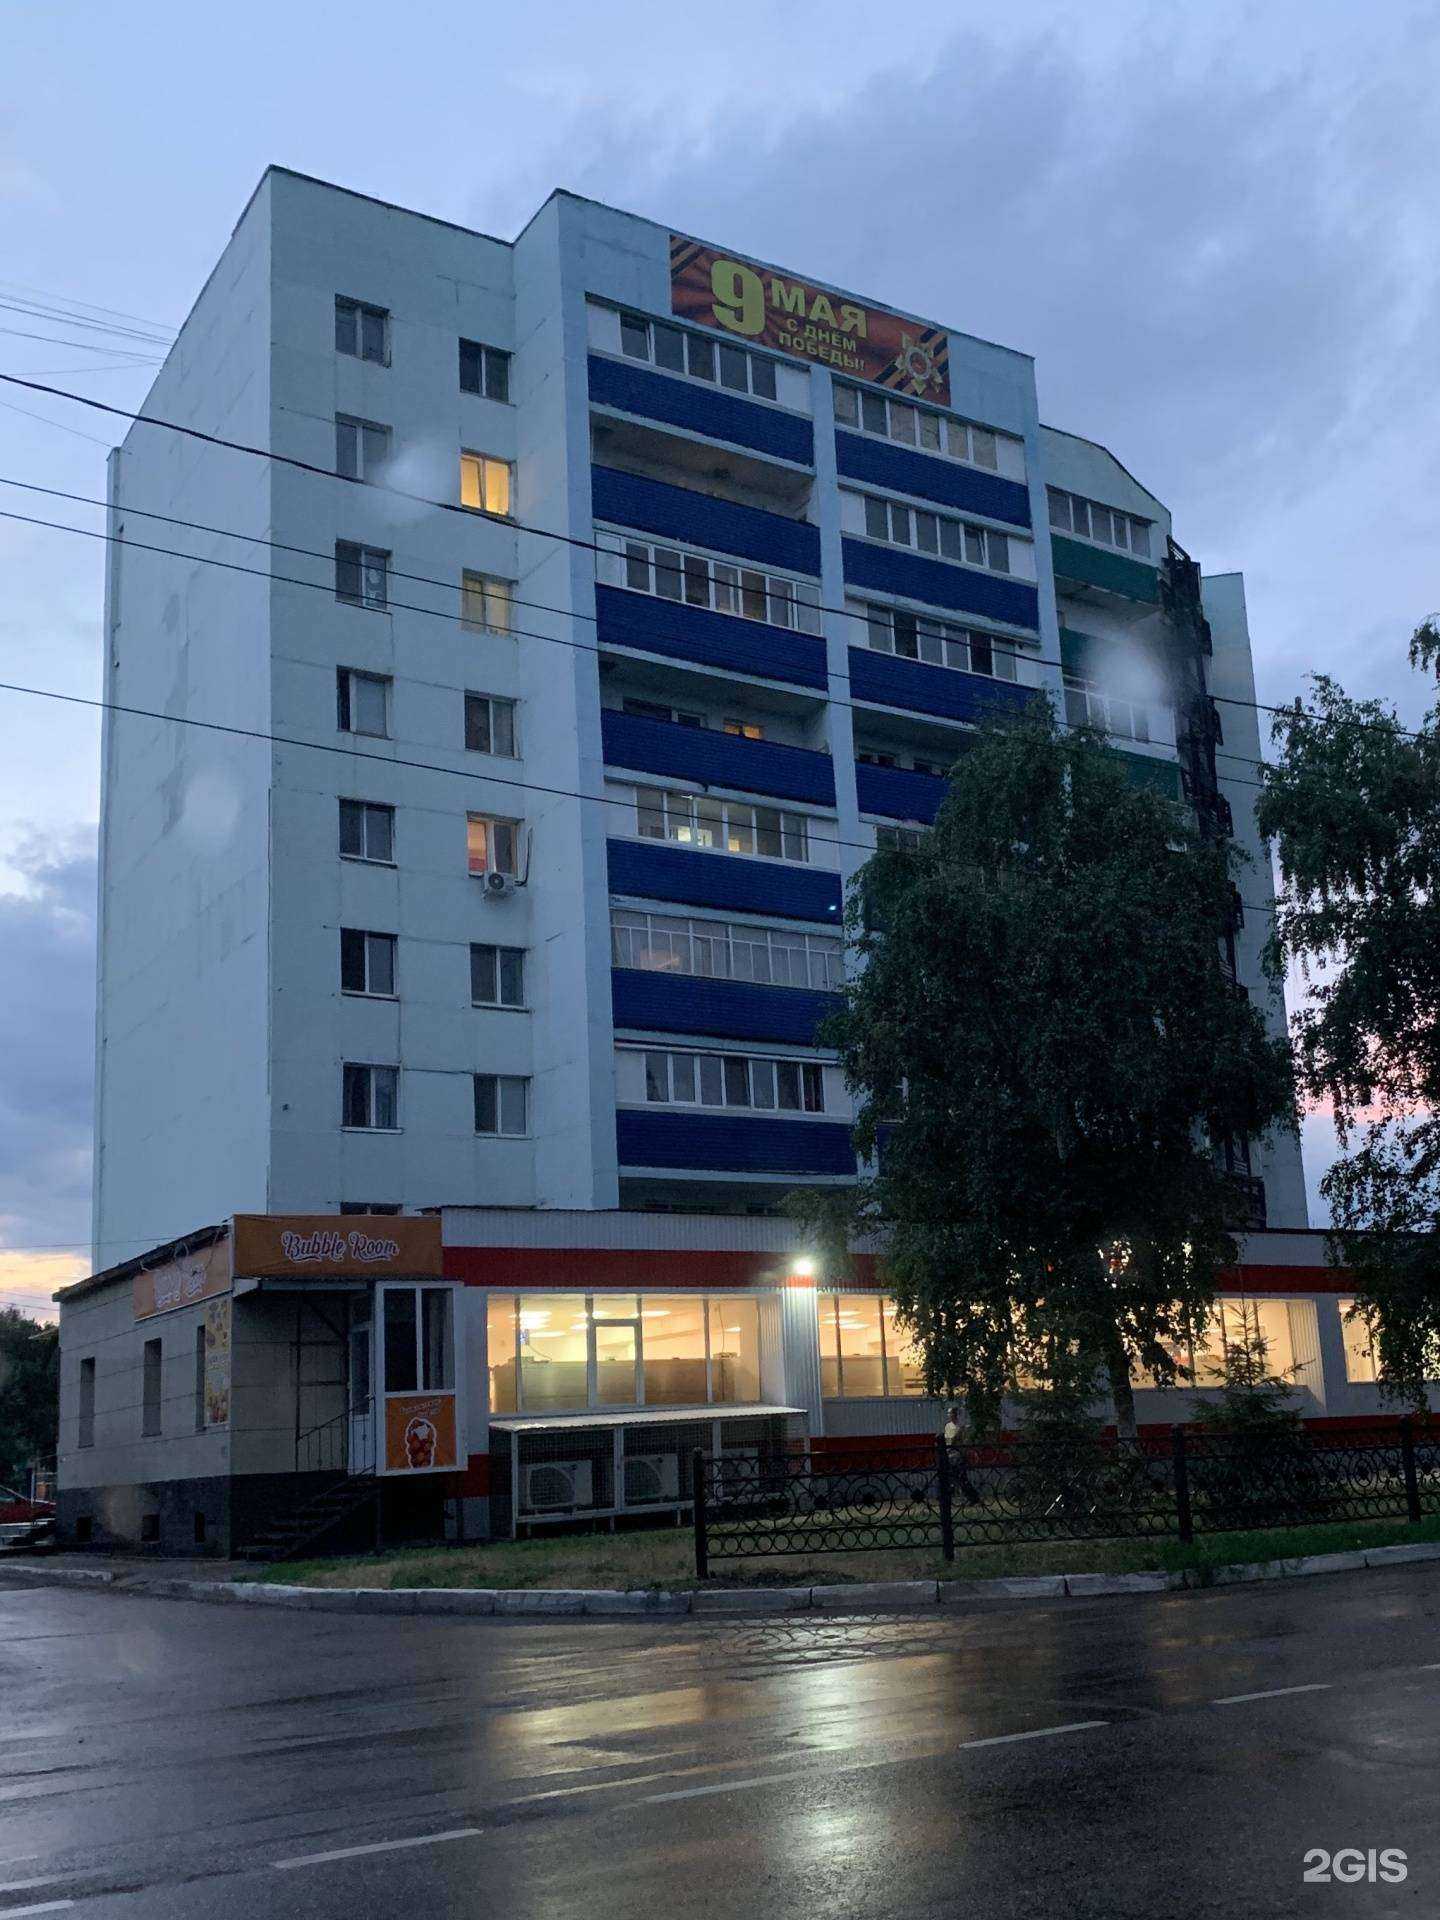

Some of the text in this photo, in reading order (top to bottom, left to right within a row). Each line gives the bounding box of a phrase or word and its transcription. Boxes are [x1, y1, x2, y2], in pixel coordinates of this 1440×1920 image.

[711, 259, 867, 338] 9 МАЯ
[787, 318, 857, 353] С ДНЕМ
[281, 1230, 400, 1262] Bubble Room
